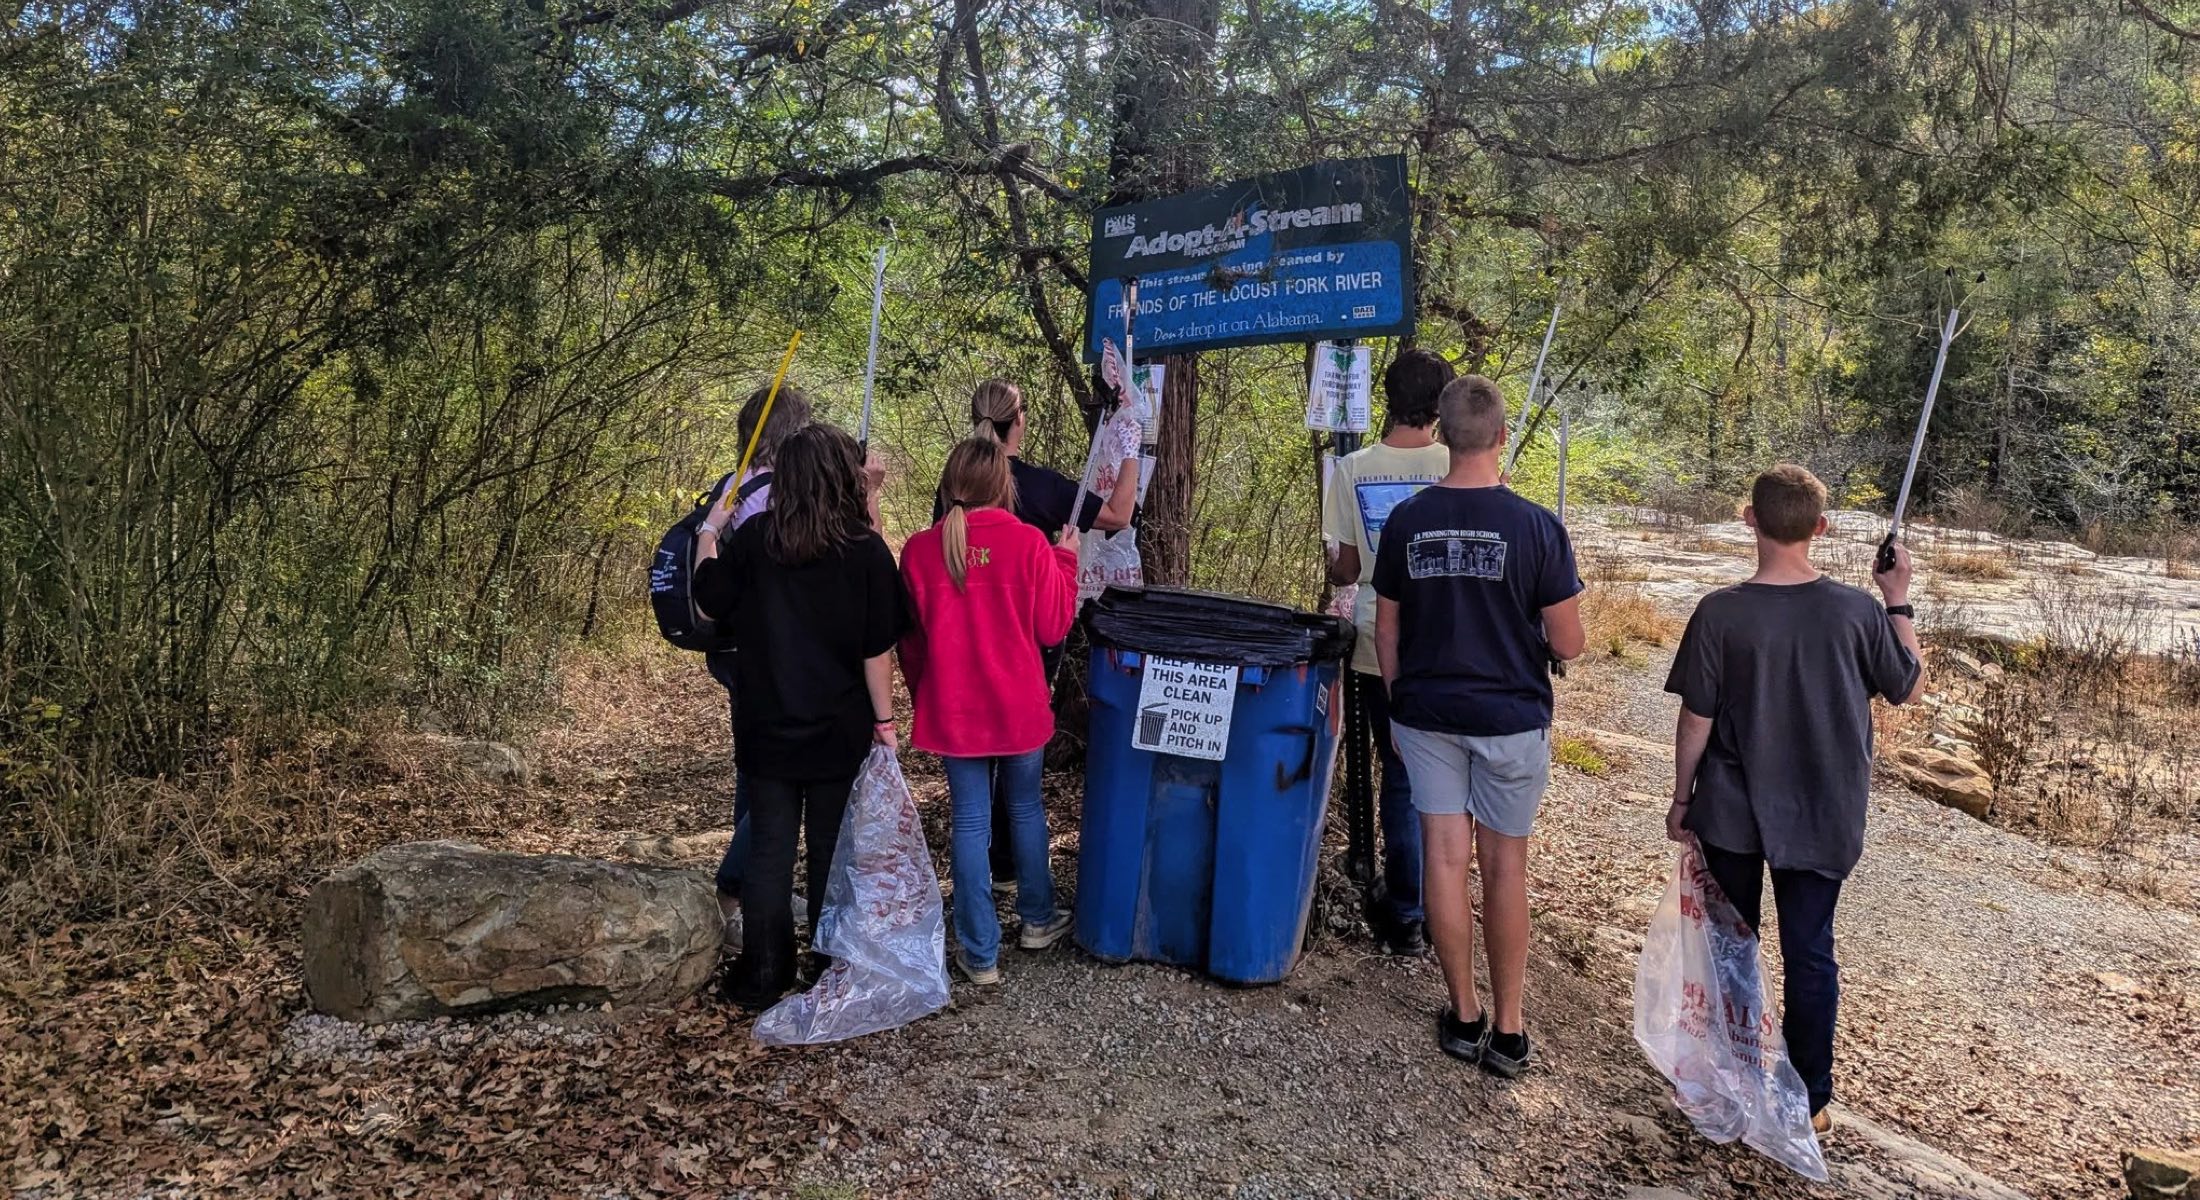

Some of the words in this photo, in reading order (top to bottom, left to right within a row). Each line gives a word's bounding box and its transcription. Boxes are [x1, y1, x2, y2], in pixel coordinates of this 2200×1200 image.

[1104, 214, 1136, 236] PALS
[1123, 202, 1363, 259] Adopt-A-Stream
[1190, 238, 1246, 258] PROGRAM
[1139, 278, 1163, 289] This
[1326, 251, 1345, 264] by
[1107, 298, 1164, 320] FRNDS
[1168, 294, 1188, 312] OF
[1192, 290, 1217, 309] THE
[1222, 280, 1279, 303] LOCUST
[1285, 275, 1329, 296] FORK
[1335, 271, 1383, 292] RIVER
[1186, 322, 1216, 338] drop
[1218, 320, 1231, 333] it
[1230, 320, 1249, 332] on
[1252, 310, 1324, 330] Alabama.
[1421, 529, 1460, 539] PENNINGTON
[1460, 529, 1476, 539] HIGH
[1475, 530, 1501, 540] SCHOOL
[1151, 655, 1189, 668] HELP
[1193, 660, 1232, 674] KEEP
[1151, 667, 1184, 683] THIS
[1187, 673, 1228, 690] AREA
[1163, 685, 1212, 704] CLEAN
[1170, 708, 1201, 723] PICK
[1205, 713, 1223, 726] UP
[1169, 721, 1197, 735] AND
[1166, 734, 1204, 750] PITCH
[1207, 740, 1221, 752] IN
